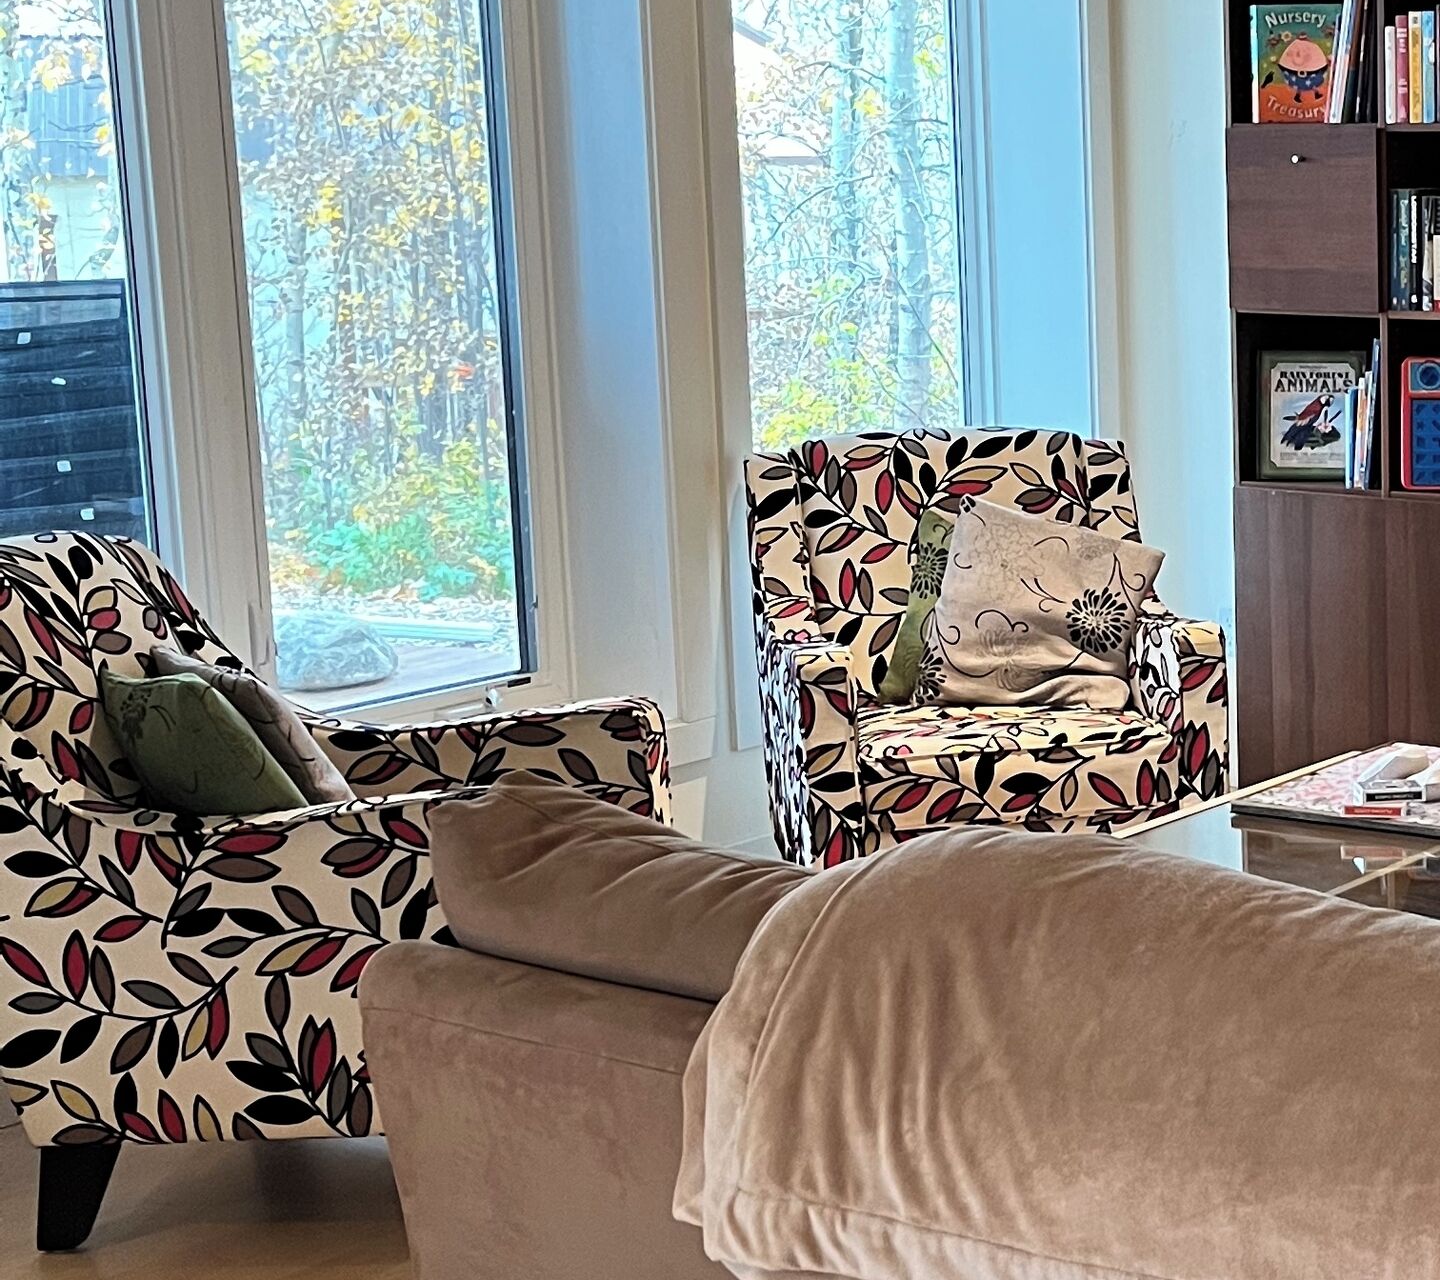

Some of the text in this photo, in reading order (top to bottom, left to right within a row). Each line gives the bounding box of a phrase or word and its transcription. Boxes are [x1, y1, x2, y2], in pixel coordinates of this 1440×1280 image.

[1265, 12, 1327, 28] Nursery
[1267, 95, 1327, 119] Treasury
[1274, 379, 1353, 395] ANIMALS
